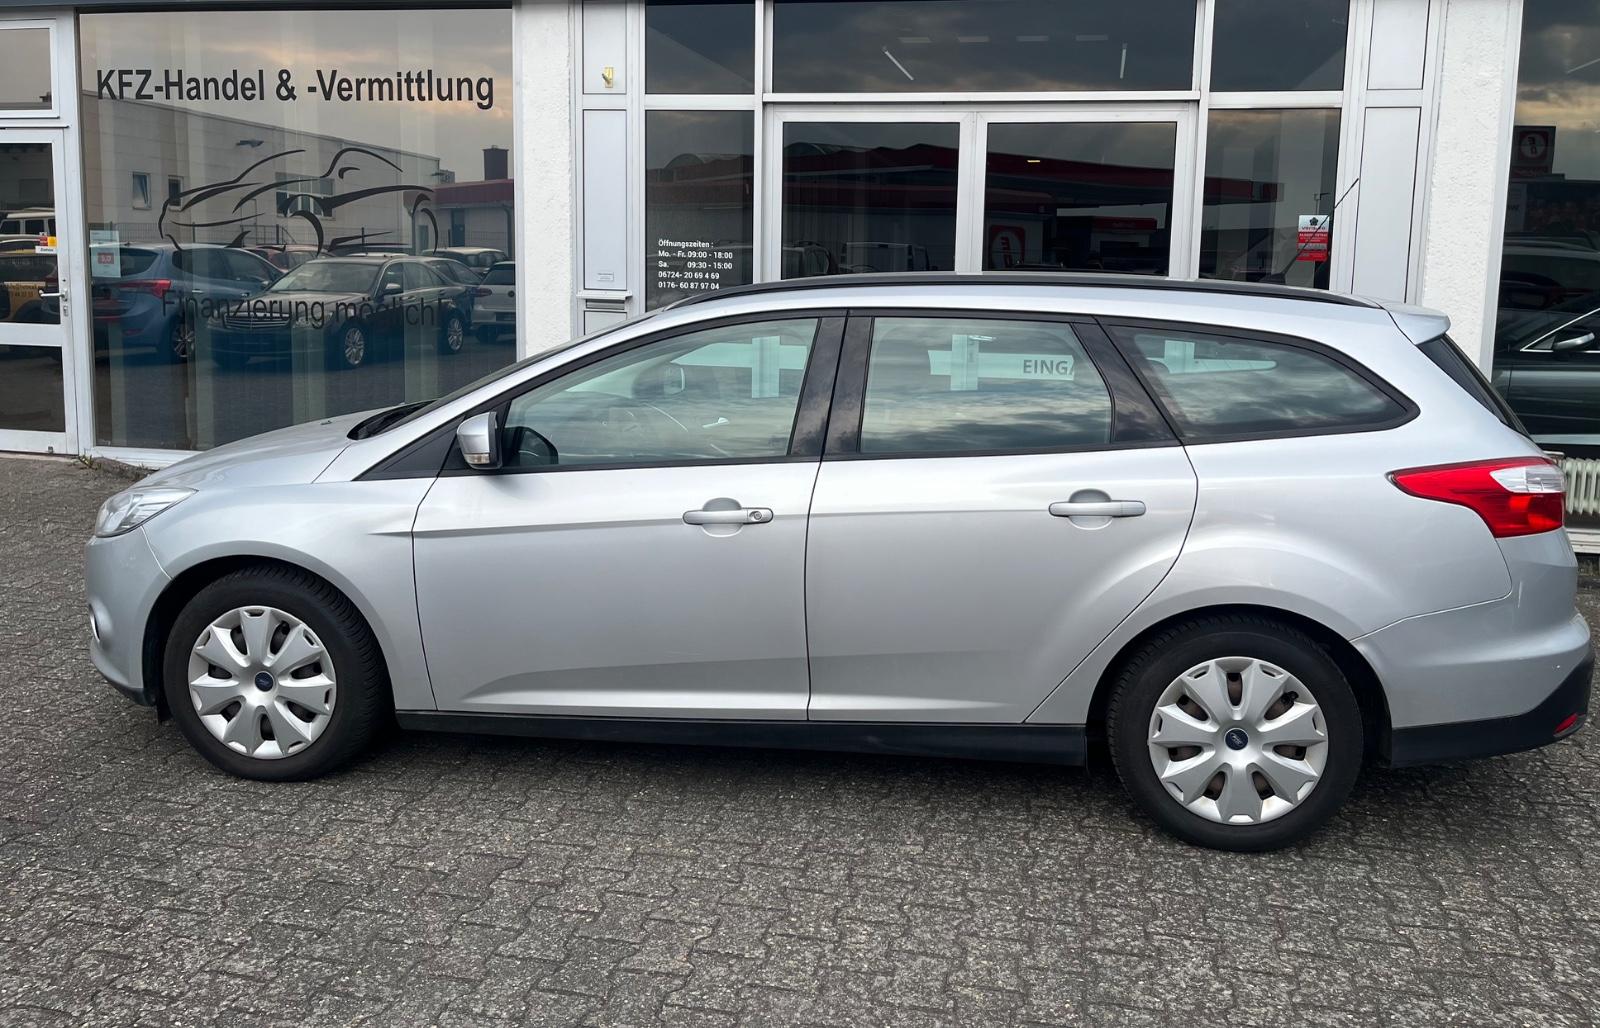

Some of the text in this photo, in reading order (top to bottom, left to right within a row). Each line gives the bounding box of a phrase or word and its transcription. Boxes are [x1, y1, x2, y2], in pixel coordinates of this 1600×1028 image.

[97, 69, 494, 110] KFZ-Handel & -Vermittlung
[687, 251, 708, 259] 09:00
[713, 251, 733, 259] 18:00
[658, 260, 669, 268] Sa.
[687, 261, 708, 269] 09:30
[713, 262, 733, 270] 15:00
[684, 271, 693, 279] 20
[680, 281, 689, 289] 60
[700, 282, 709, 290] 97
[710, 282, 720, 290] 04
[162, 288, 325, 329] Finanzierung
